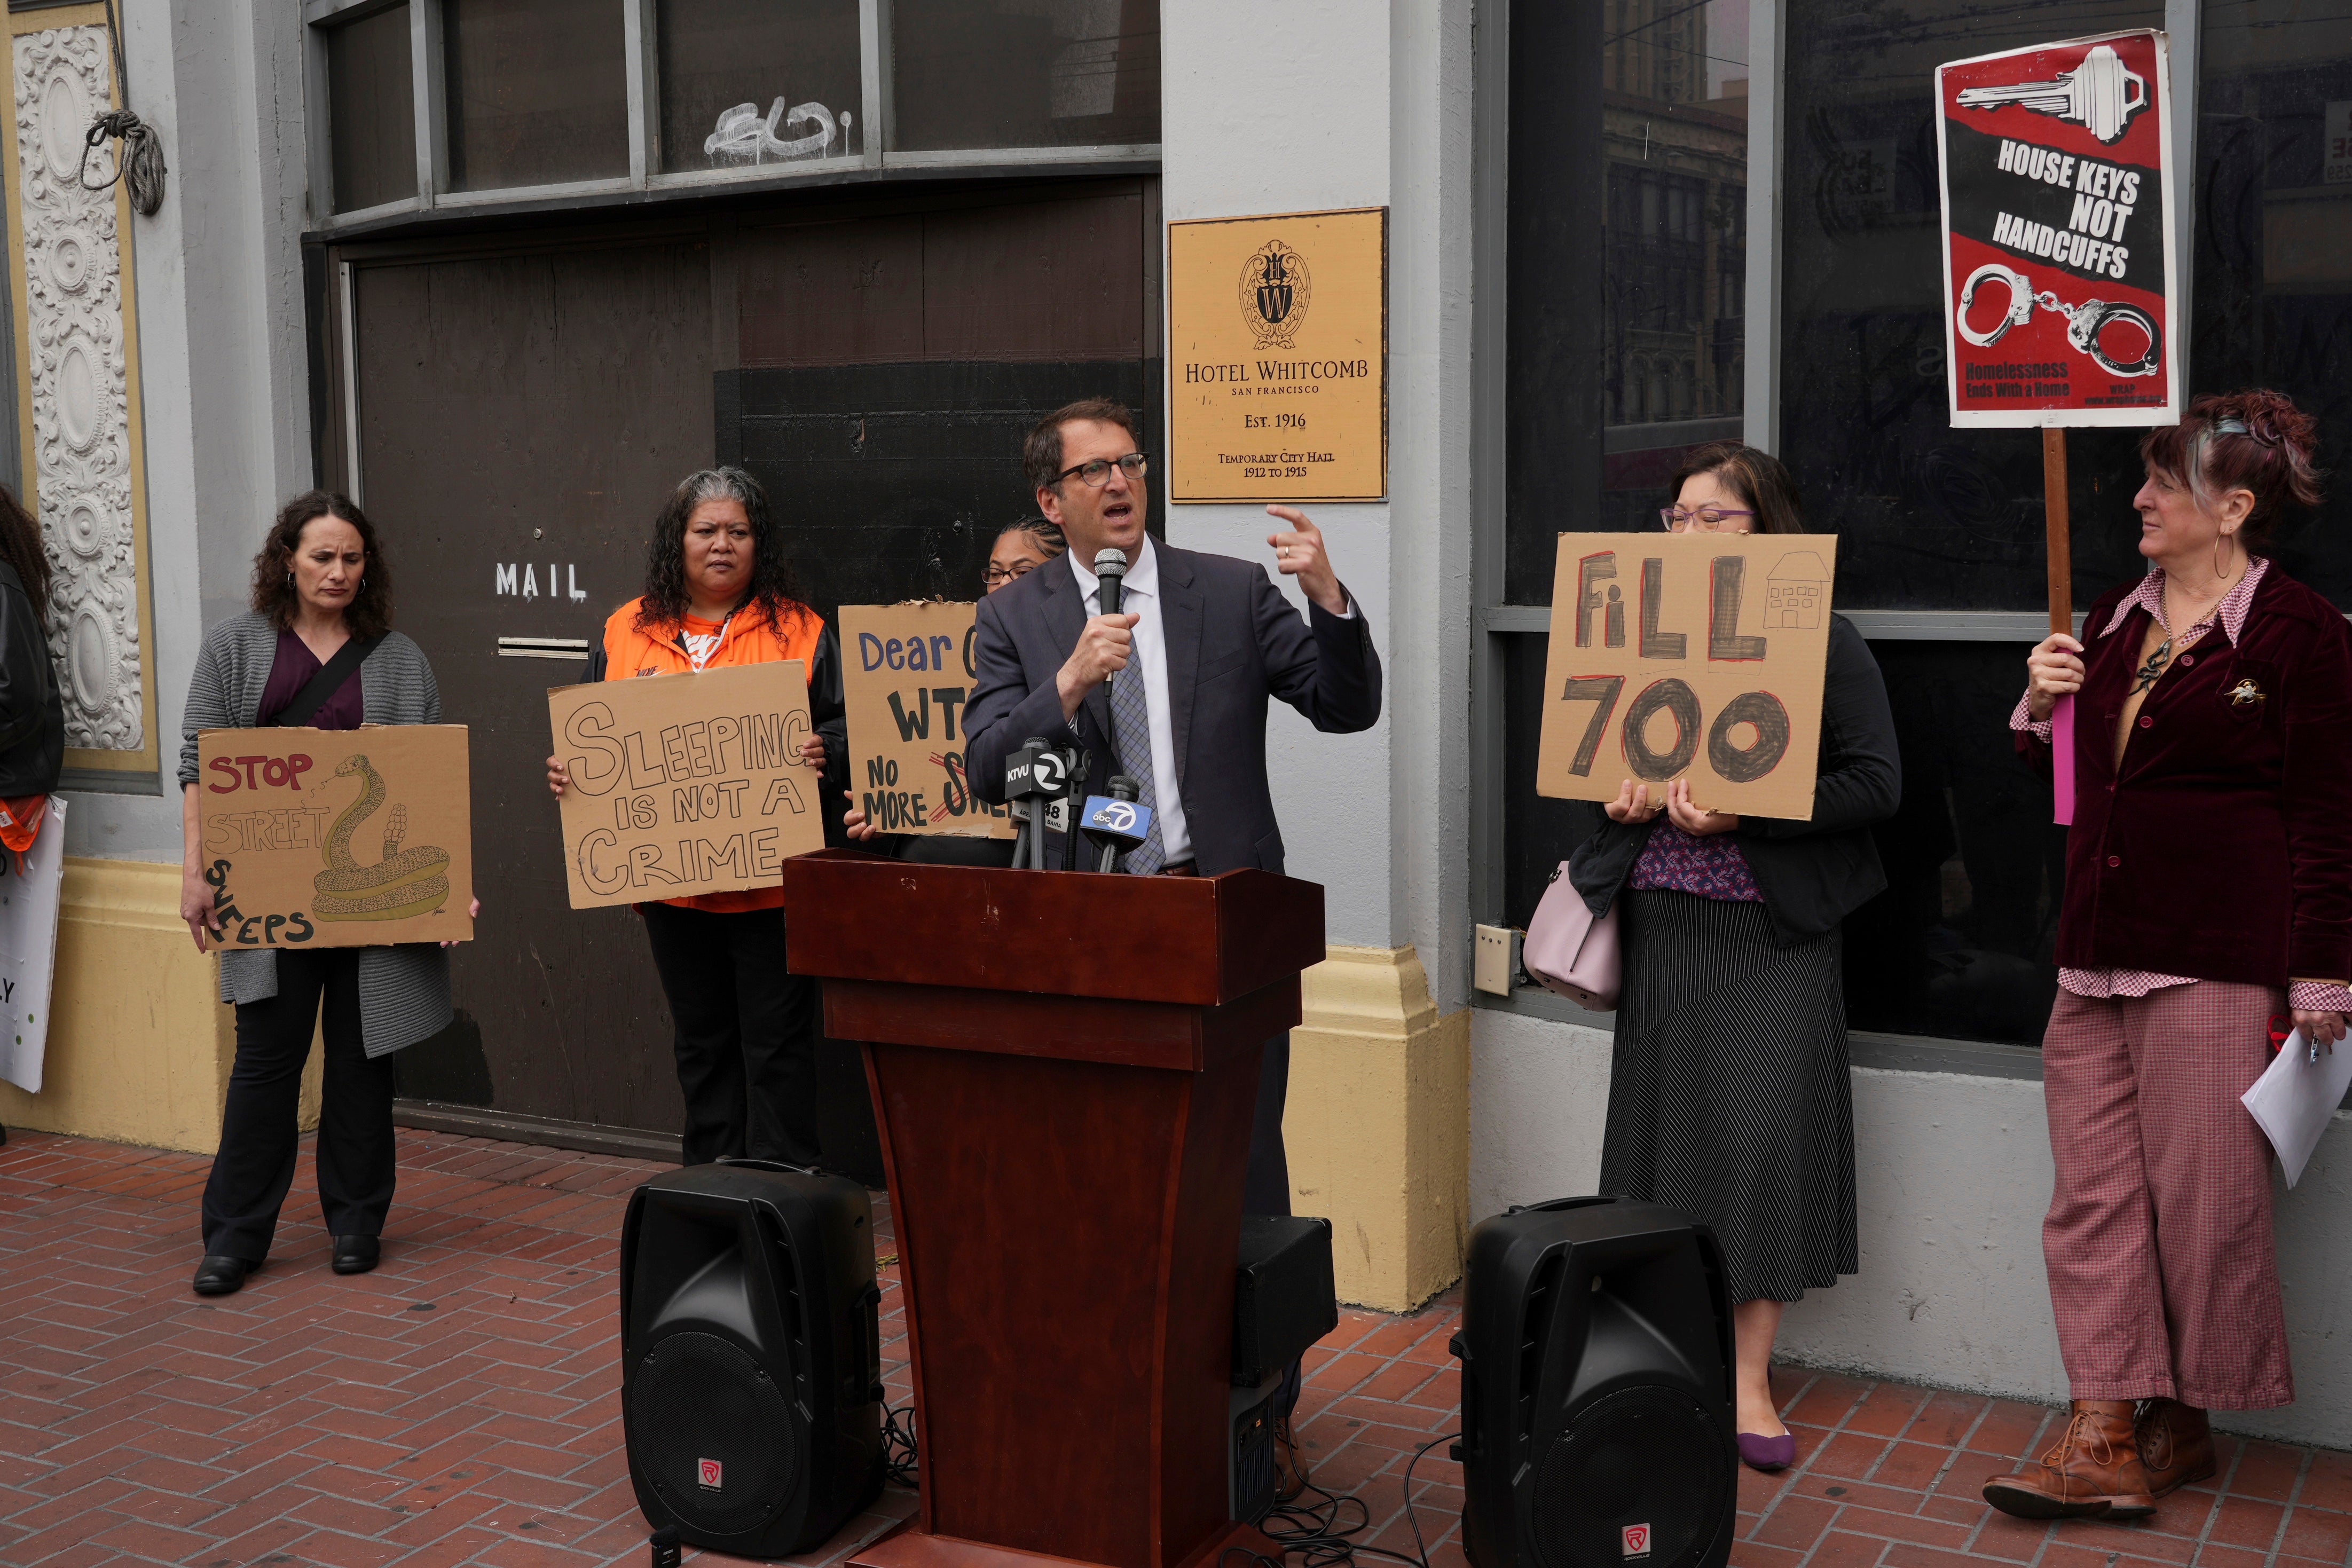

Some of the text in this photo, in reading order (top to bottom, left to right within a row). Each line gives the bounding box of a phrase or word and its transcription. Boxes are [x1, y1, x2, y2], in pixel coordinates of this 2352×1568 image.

[1997, 139, 2140, 204] HOUSE KEYS
[2068, 193, 2134, 243] NOT
[1992, 211, 2129, 279] HANDCUFFS
[1186, 360, 1368, 383] HOTEL WHITCOMB
[1965, 361, 2068, 381] Homelessness
[1232, 385, 1319, 396] SAN FRANCISCO
[1966, 381, 2070, 398] Ends With a Home
[2109, 384, 2136, 395] WRAP
[1245, 413, 1306, 428] EST. 1916
[1218, 452, 1335, 463] TEMPORARY CITY HALL
[1244, 467, 1307, 477] 1912 TO 1915
[496, 563, 586, 598] MAIL
[859, 632, 953, 671] Dear
[636, 665, 659, 677] NIKE
[887, 687, 971, 742] WT
[1561, 674, 1791, 783] 700
[565, 702, 815, 796] SLEEPING
[208, 754, 313, 794] STOP
[867, 755, 898, 789] NO
[1007, 763, 1029, 783] KTVU
[616, 778, 806, 830] IS NOT A
[862, 790, 927, 831] MORE
[1019, 808, 1031, 817] ÁRE
[1092, 813, 1112, 823] abc
[205, 807, 330, 854] STREET
[1047, 820, 1061, 829] BAHÍA
[578, 828, 782, 895] CRIME
[1624, 1553, 1650, 1562] ROCKVILLE
